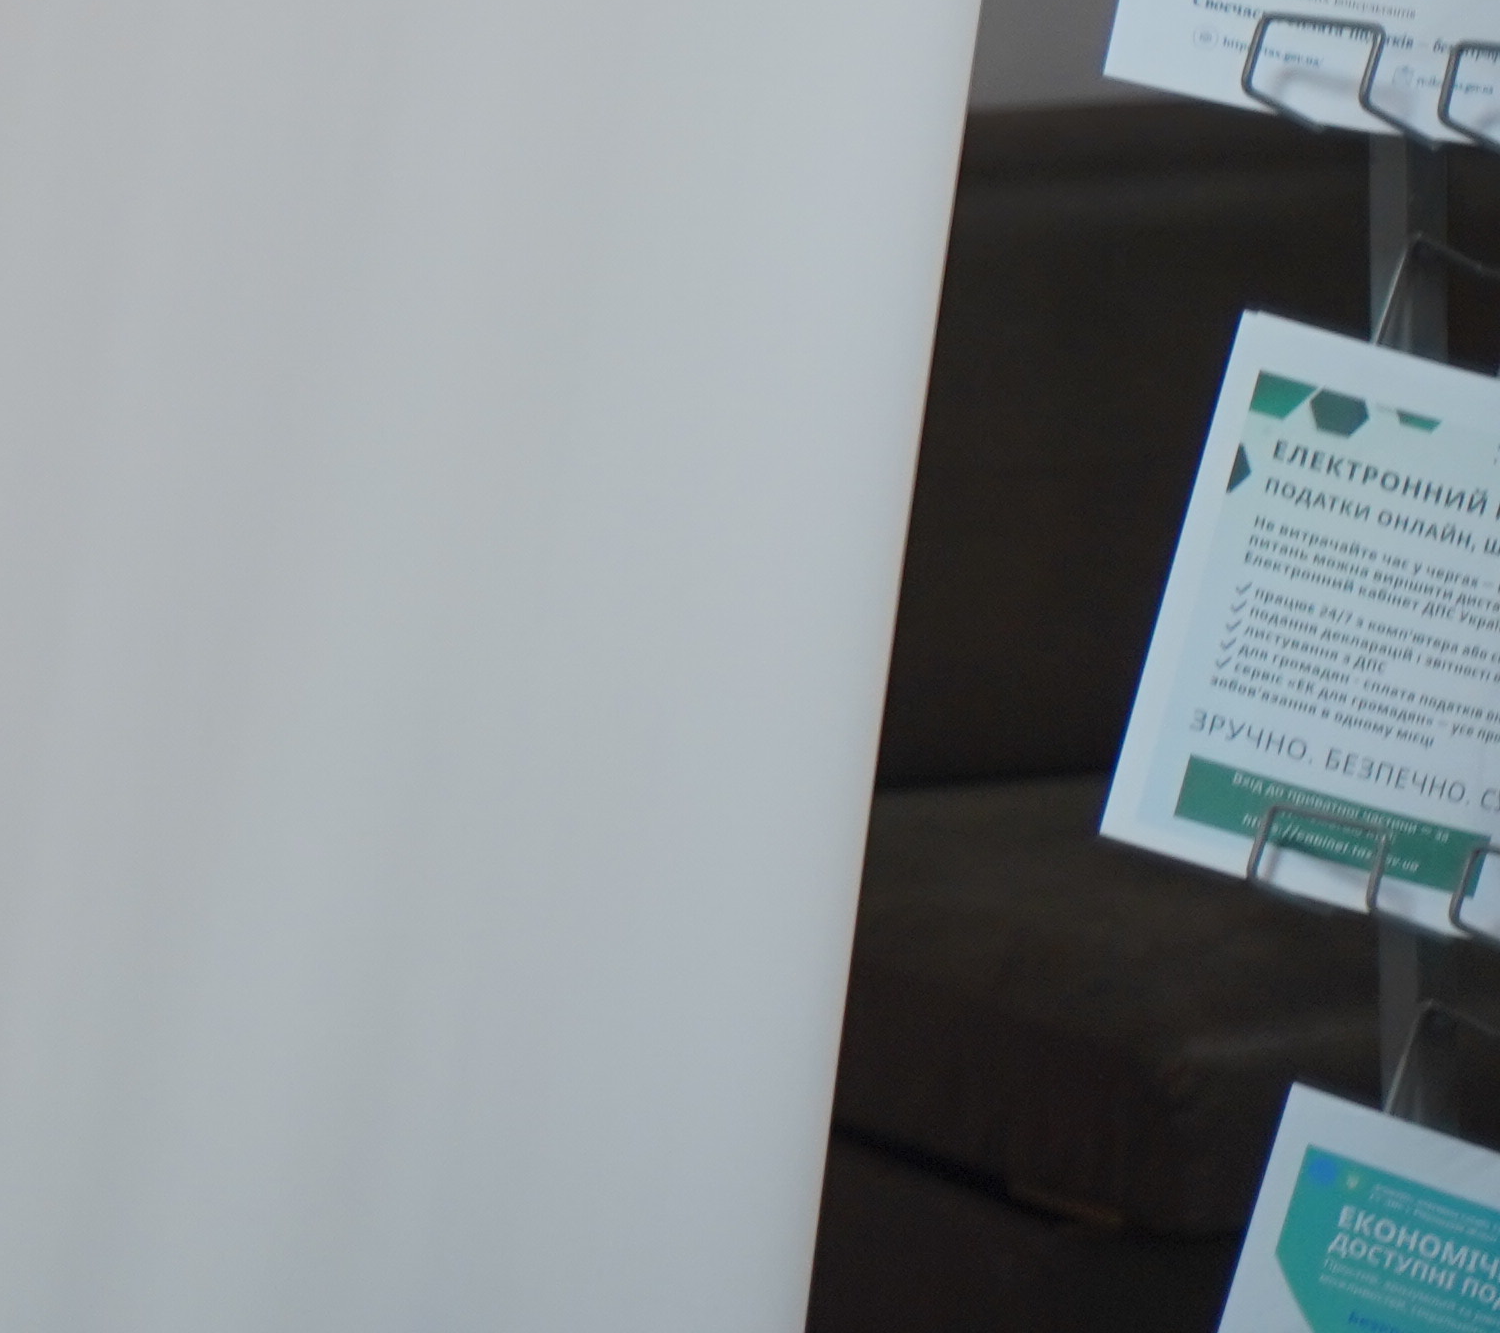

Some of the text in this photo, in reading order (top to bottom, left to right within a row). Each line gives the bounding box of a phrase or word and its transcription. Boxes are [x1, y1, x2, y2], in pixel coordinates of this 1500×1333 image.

[1263, 477, 1479, 551] ПОДАТКИ ОНЛАЙН,
[1271, 440, 1488, 517] ЕЛЕКТРОННИЙ
[1243, 551, 1355, 592] Електронний
[1358, 582, 1419, 609] кабінет
[1422, 601, 1454, 621] ДПС
[1248, 537, 1309, 561] питань
[1312, 554, 1369, 577] можна
[1372, 570, 1453, 600] вирішити
[1252, 515, 1478, 590] Не витрачайте час у чергах
[1243, 625, 1339, 662] листування
[1352, 654, 1386, 676] ДПС
[1248, 606, 1318, 635] подання
[1320, 625, 1413, 662] декларацій
[1424, 654, 1491, 682] звітності
[1253, 587, 1315, 616] працює
[1318, 604, 1353, 626] 24/7
[1461, 642, 1489, 661] або
[1210, 675, 1317, 715] зобов'язання
[1333, 711, 1392, 738] одному
[1395, 727, 1434, 749] місці
[1232, 663, 1281, 687] сервіс
[1317, 685, 1347, 705] для
[1237, 643, 1483, 721] для громадян сплата податків
[1186, 708, 1474, 807] ЗРУЧНО. БЕЗПЕЧНО.
[1231, 771, 1264, 793] Вхід
[1263, 780, 1285, 800] до
[1361, 810, 1417, 835] частини
[1328, 1229, 1456, 1291] ДОСТУПНІ
[1336, 1203, 1500, 1280] ЕКОНОМІЧ
